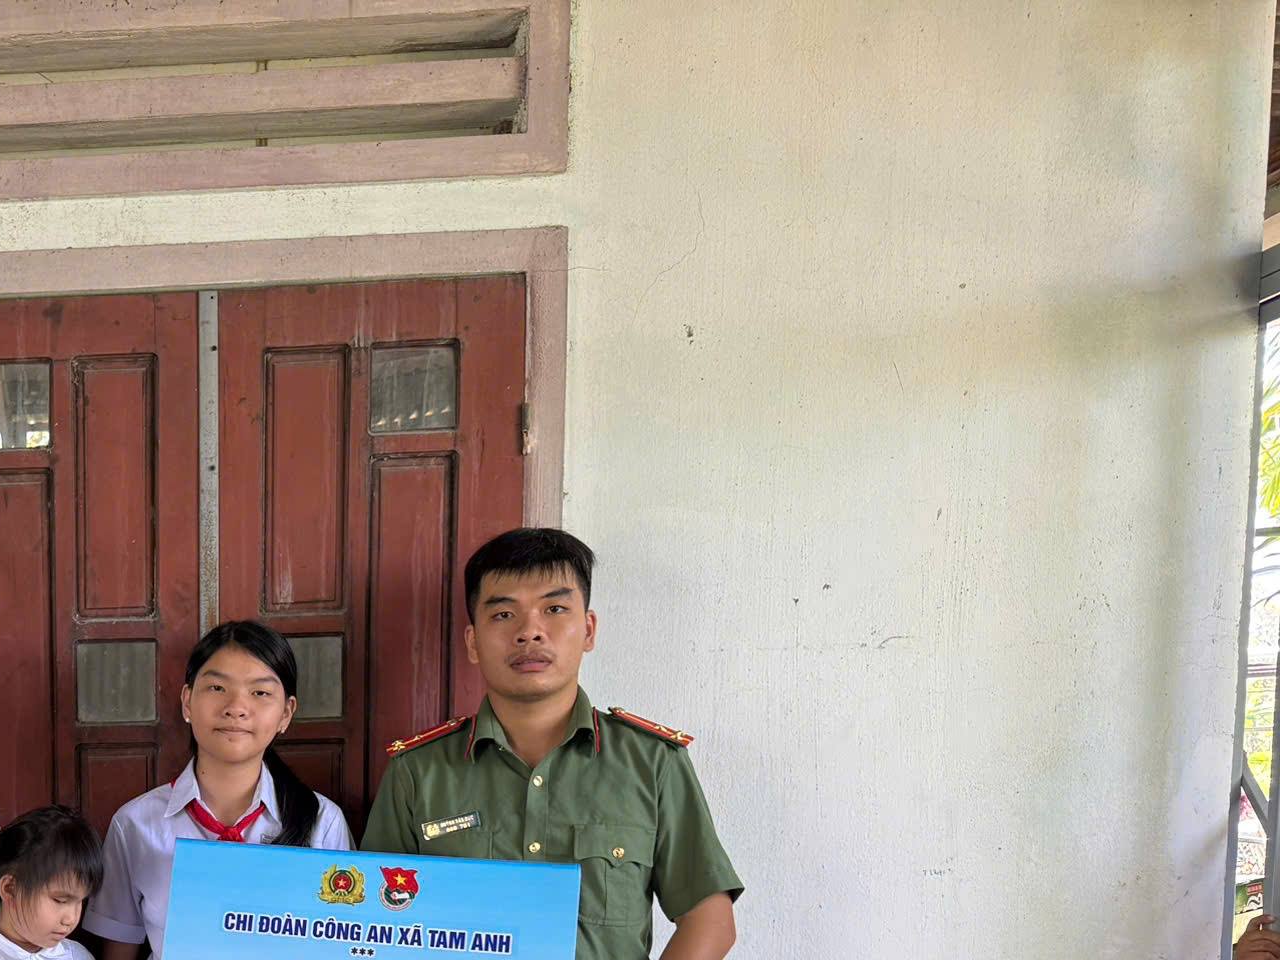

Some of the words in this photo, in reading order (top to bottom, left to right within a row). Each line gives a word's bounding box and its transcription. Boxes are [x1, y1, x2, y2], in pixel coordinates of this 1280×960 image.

[223, 911, 253, 932] CHI
[258, 914, 307, 937] ĐOÀN
[312, 917, 361, 941] CÔNG
[366, 925, 392, 944] AN
[397, 924, 422, 946] XÃ
[428, 929, 466, 949] TAM
[470, 933, 511, 953] ANH
